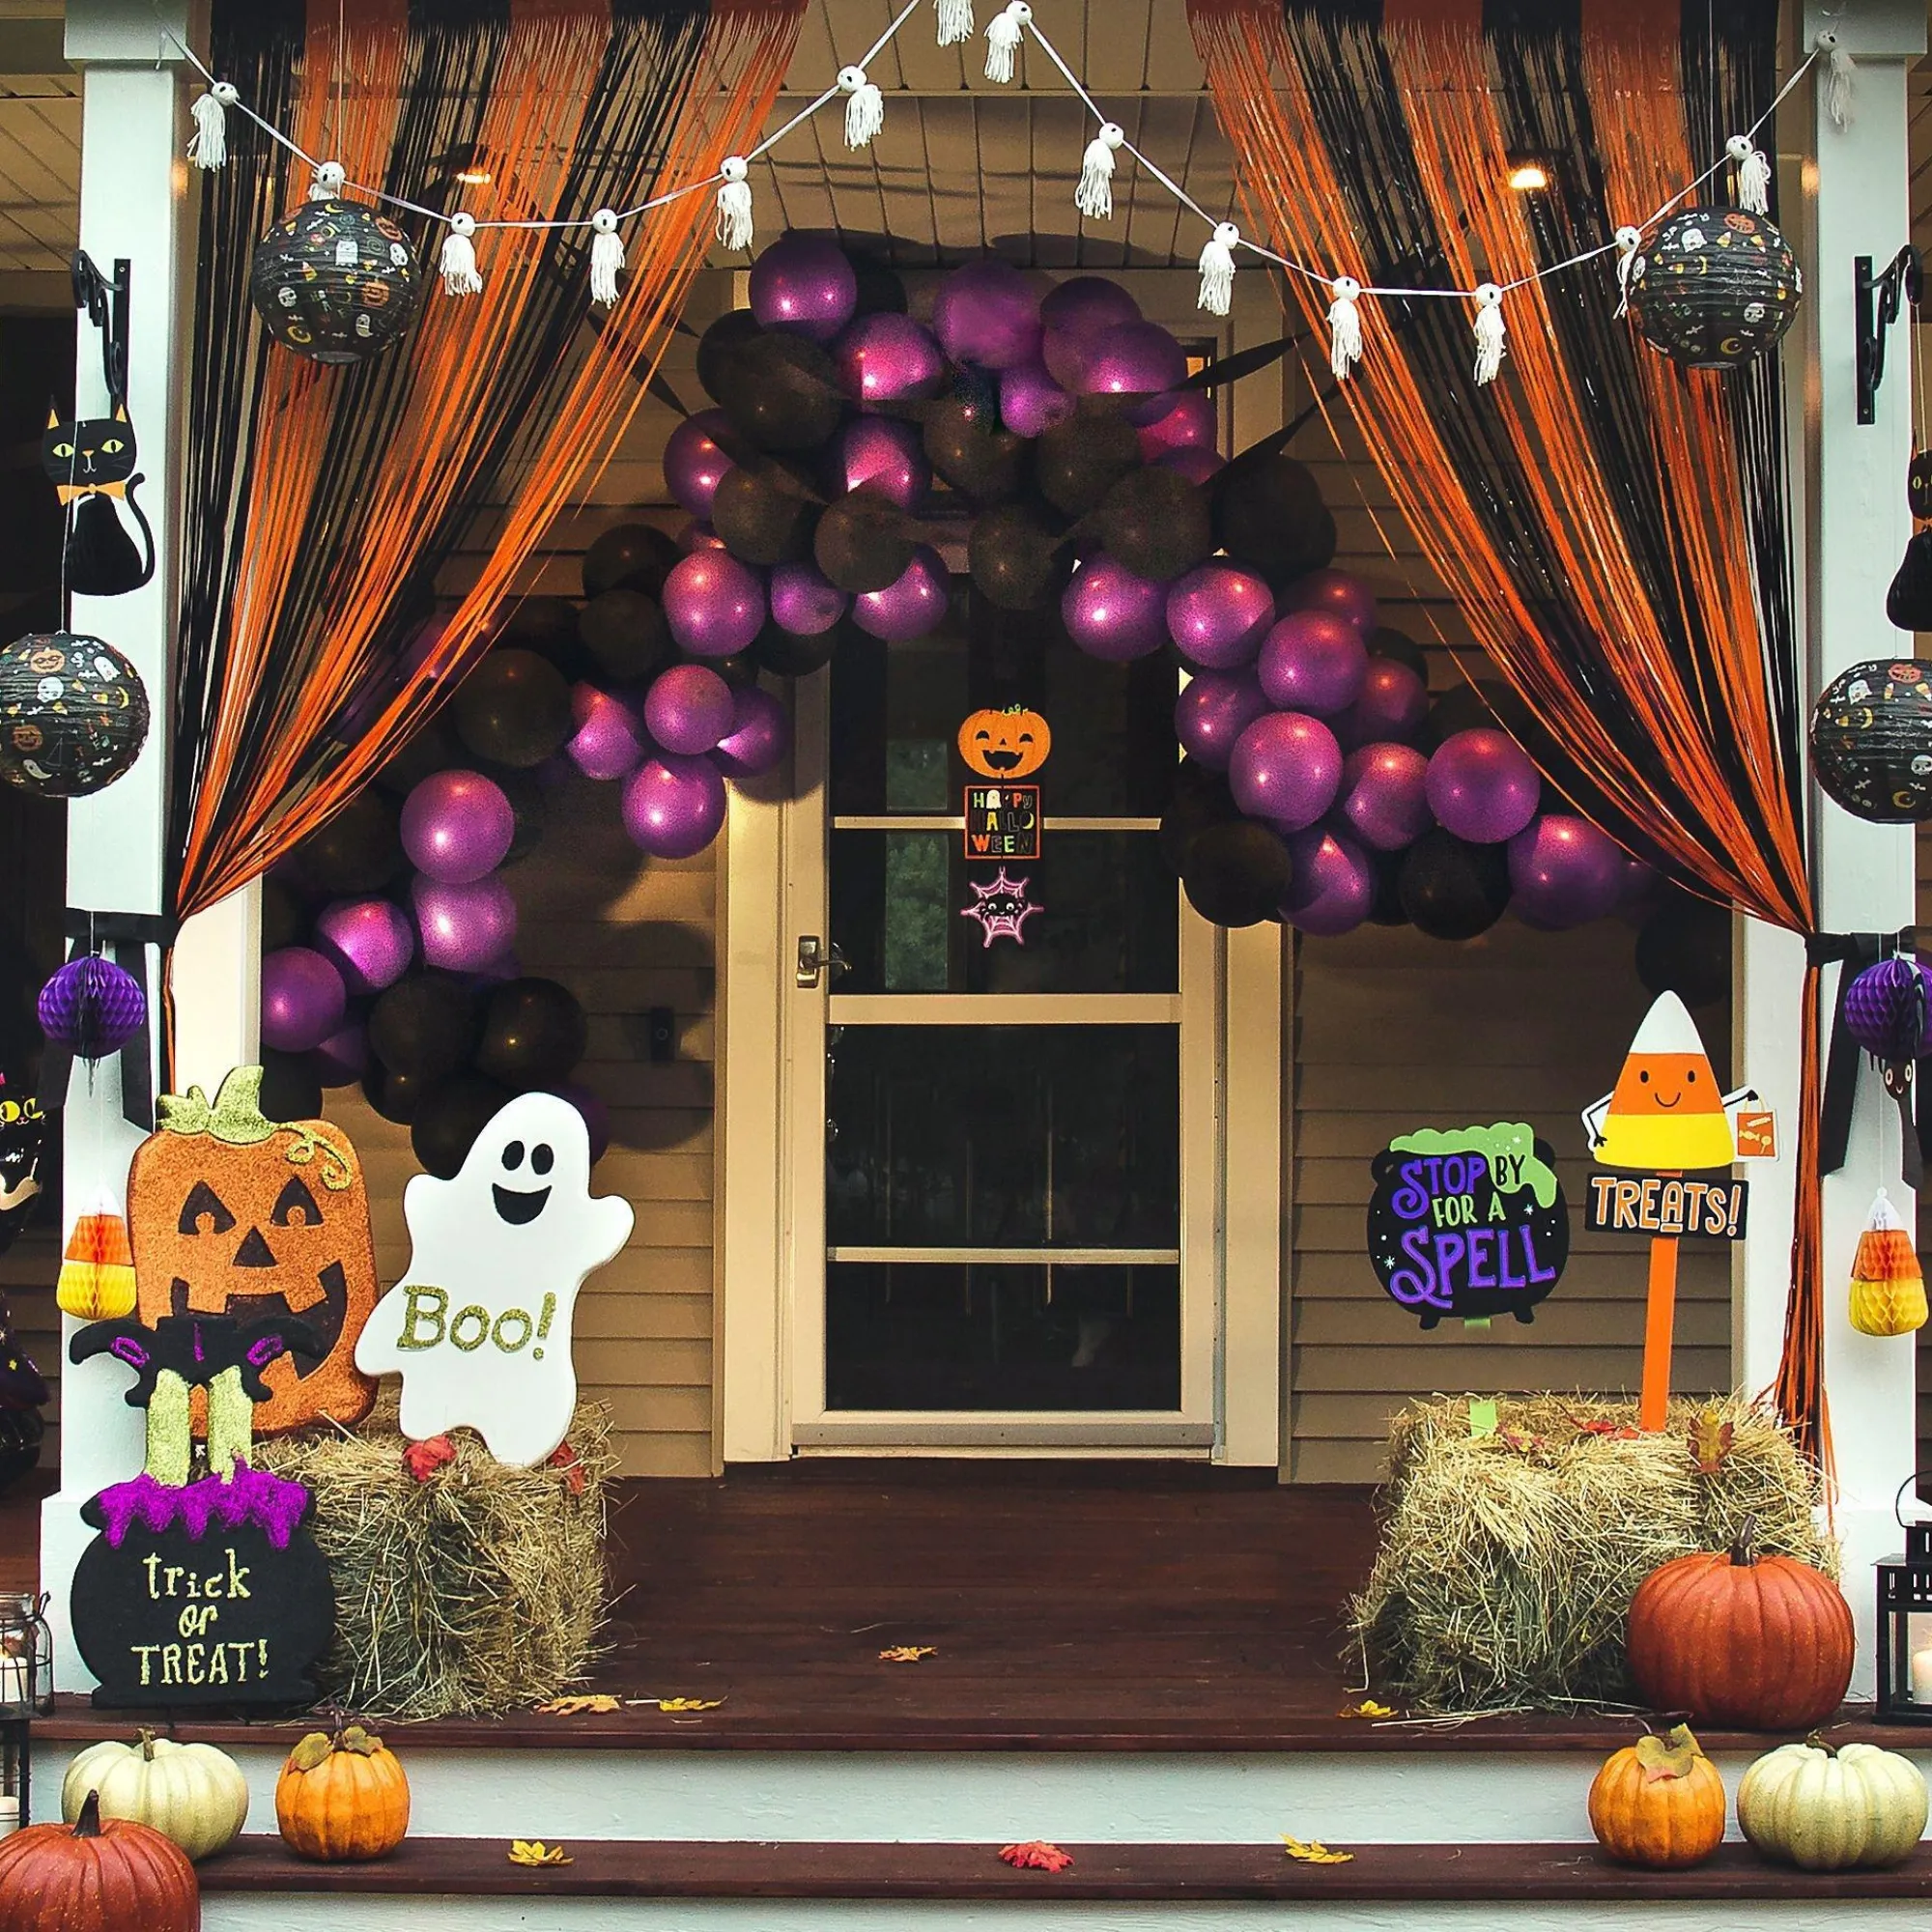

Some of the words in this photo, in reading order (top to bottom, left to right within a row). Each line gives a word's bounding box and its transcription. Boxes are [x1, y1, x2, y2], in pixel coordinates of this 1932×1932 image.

[1391, 1155, 1486, 1219] STOP
[1494, 1152, 1525, 1186] BY
[1432, 1194, 1478, 1228] FOR
[1488, 1191, 1506, 1222] A
[1591, 1177, 1742, 1236] TREATS!
[1389, 1224, 1556, 1309] SPELL
[178, 1605, 218, 1638] or
[130, 1639, 269, 1685] TREAT!
